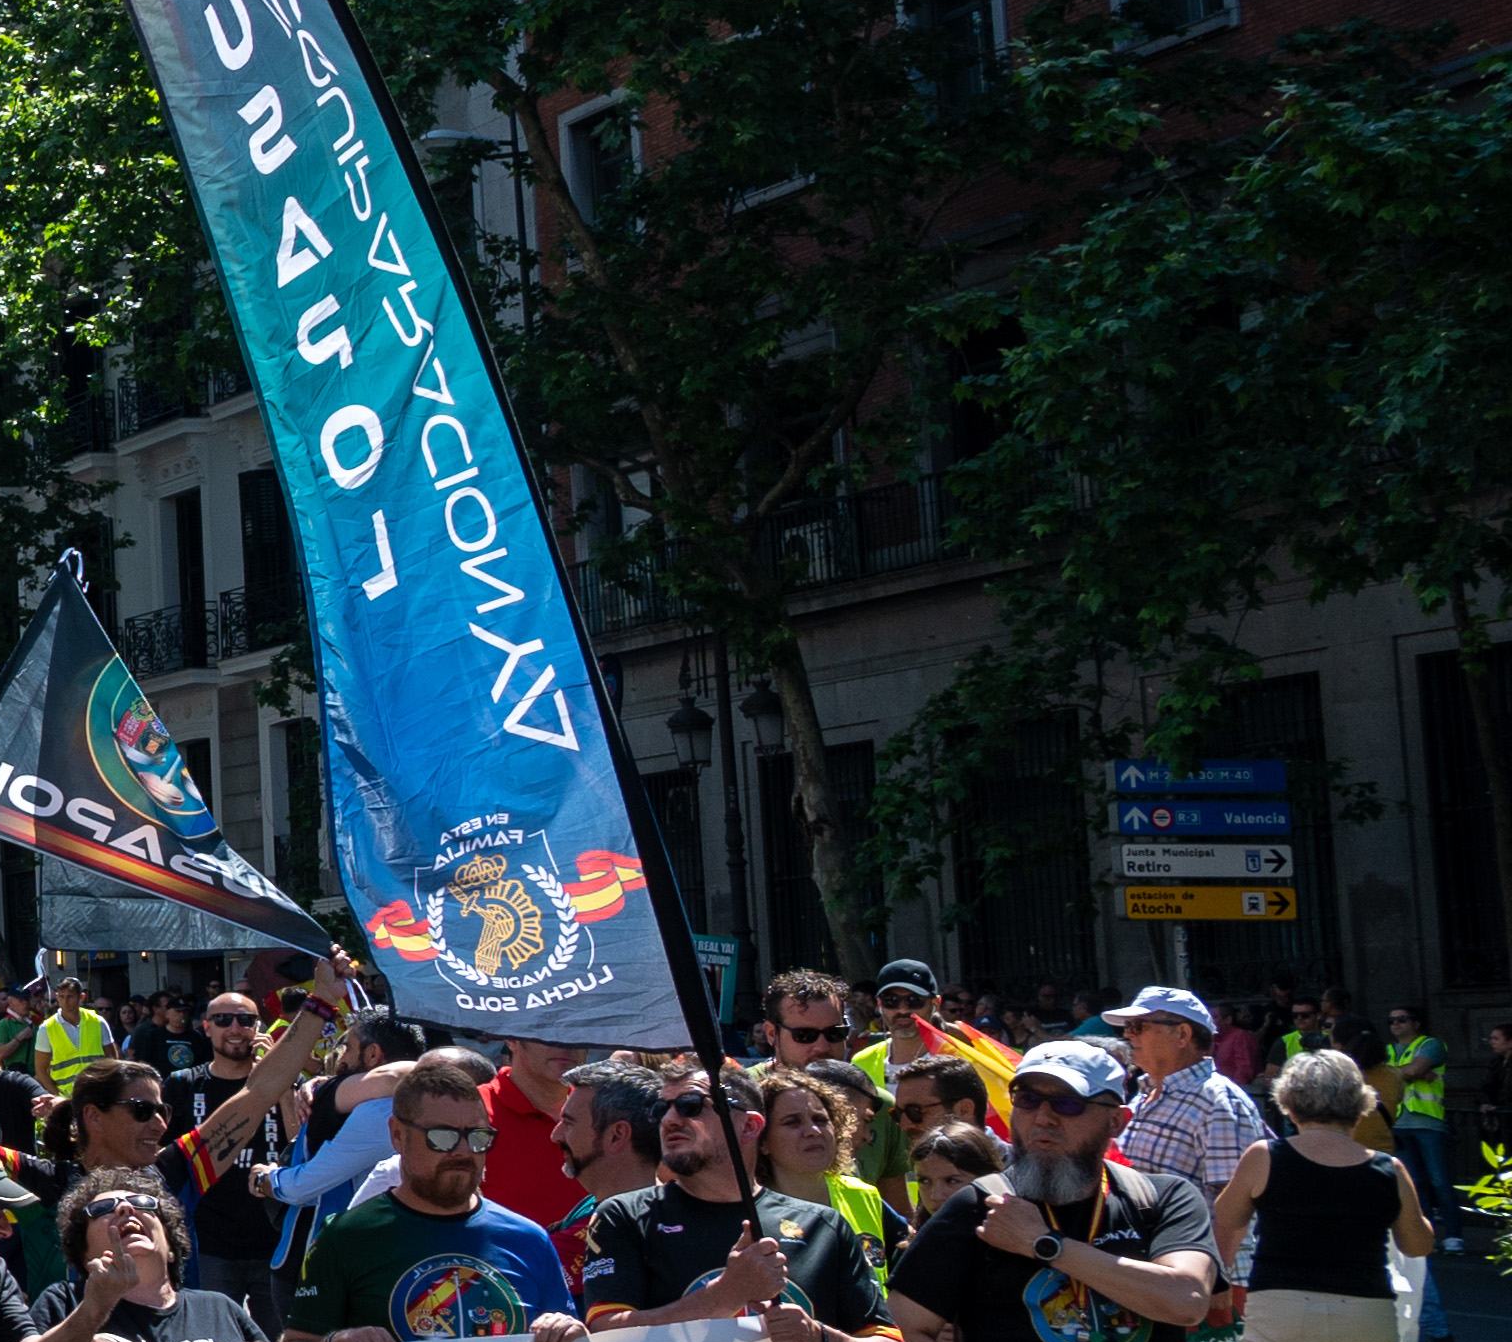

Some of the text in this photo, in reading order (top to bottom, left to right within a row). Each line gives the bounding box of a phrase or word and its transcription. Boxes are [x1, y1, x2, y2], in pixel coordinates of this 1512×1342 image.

[1177, 812, 1286, 824] R-3 Valencia
[1126, 847, 1215, 859] Junta Municipal
[1127, 861, 1172, 873] Retiro
[1181, 891, 1195, 900] de
[1130, 902, 1183, 915] Atocha
